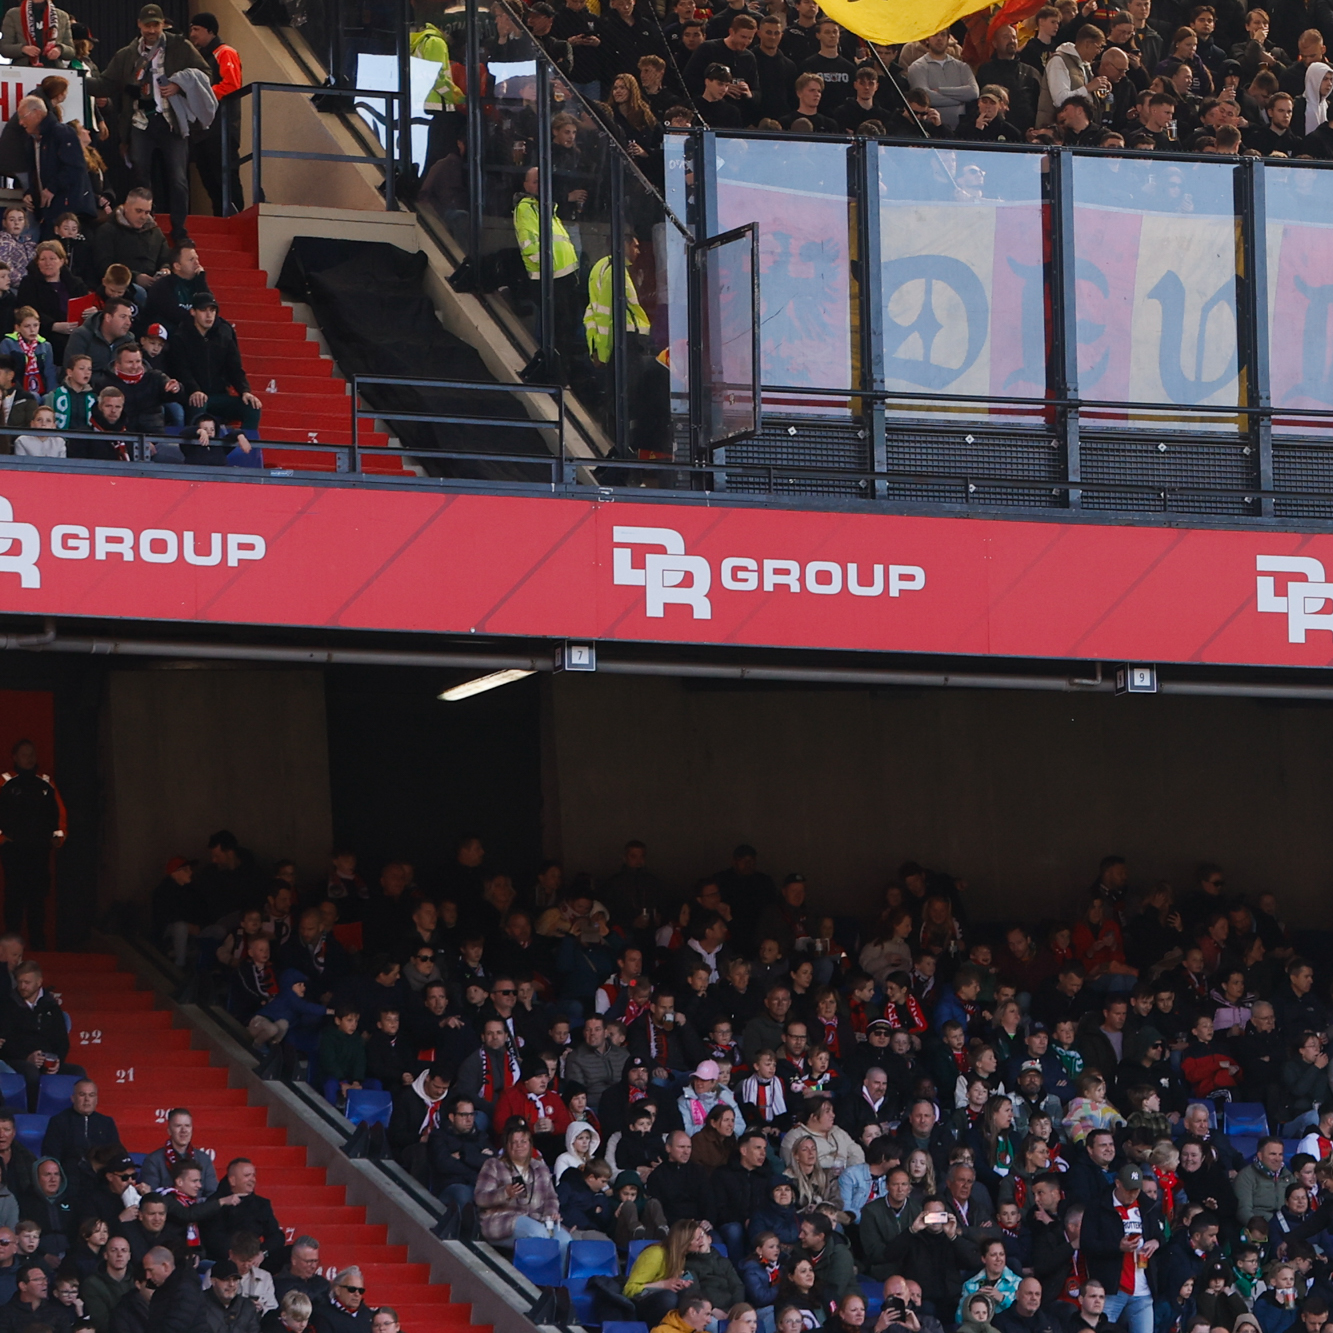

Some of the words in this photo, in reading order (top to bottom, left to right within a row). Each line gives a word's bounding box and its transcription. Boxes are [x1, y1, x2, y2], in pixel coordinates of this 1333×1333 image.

[265, 379, 278, 394] 4
[0, 495, 40, 589] R
[51, 524, 266, 567] GROUP
[721, 557, 926, 599] GROUP
[80, 1030, 102, 1045] 22
[116, 1068, 135, 1083] 21
